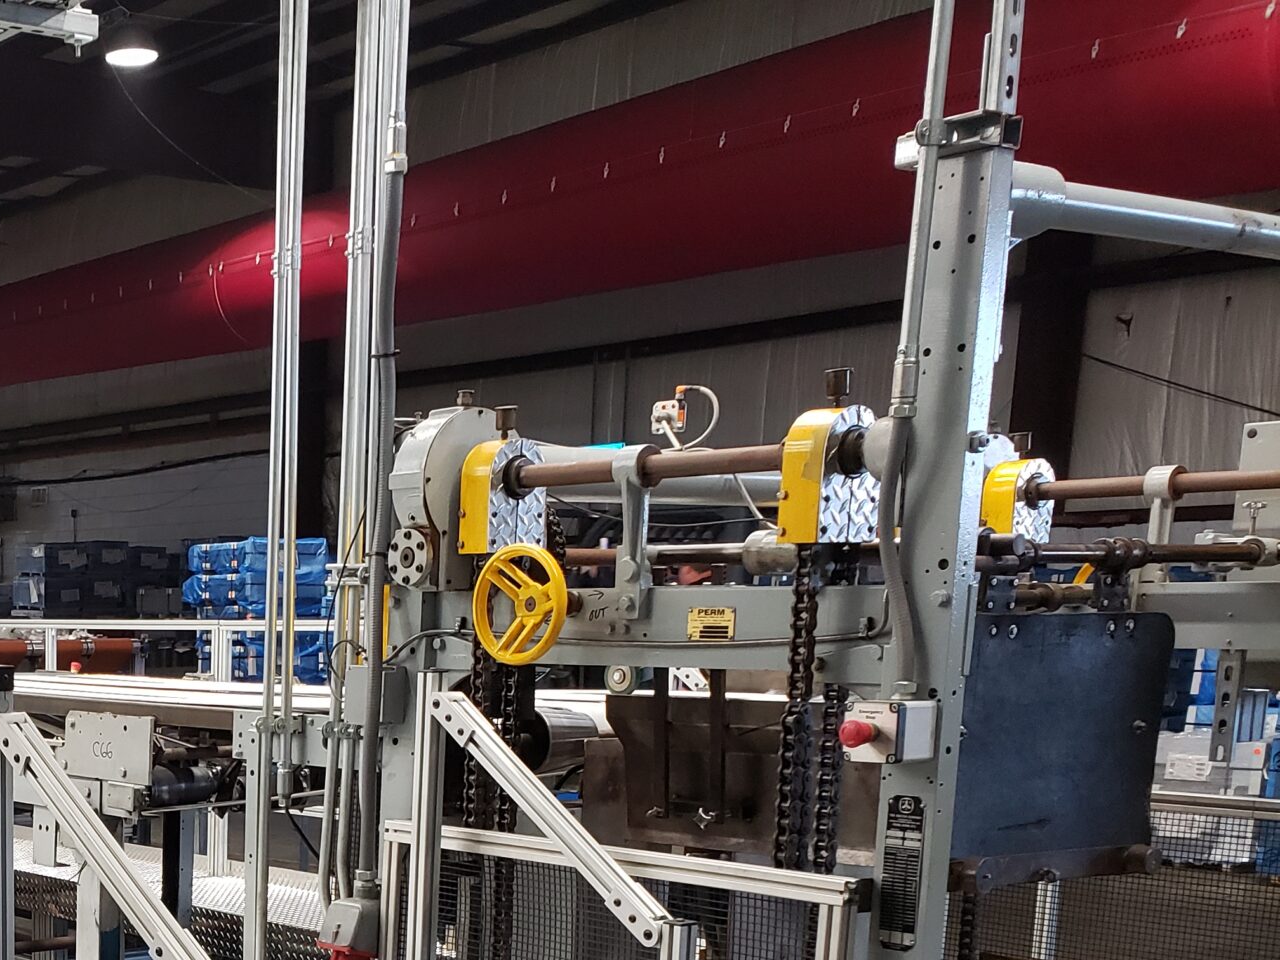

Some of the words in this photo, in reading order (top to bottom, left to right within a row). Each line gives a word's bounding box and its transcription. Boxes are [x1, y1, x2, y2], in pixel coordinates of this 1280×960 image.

[589, 606, 608, 621] OUT
[697, 608, 725, 616] PERM
[92, 741, 113, 759] C66
